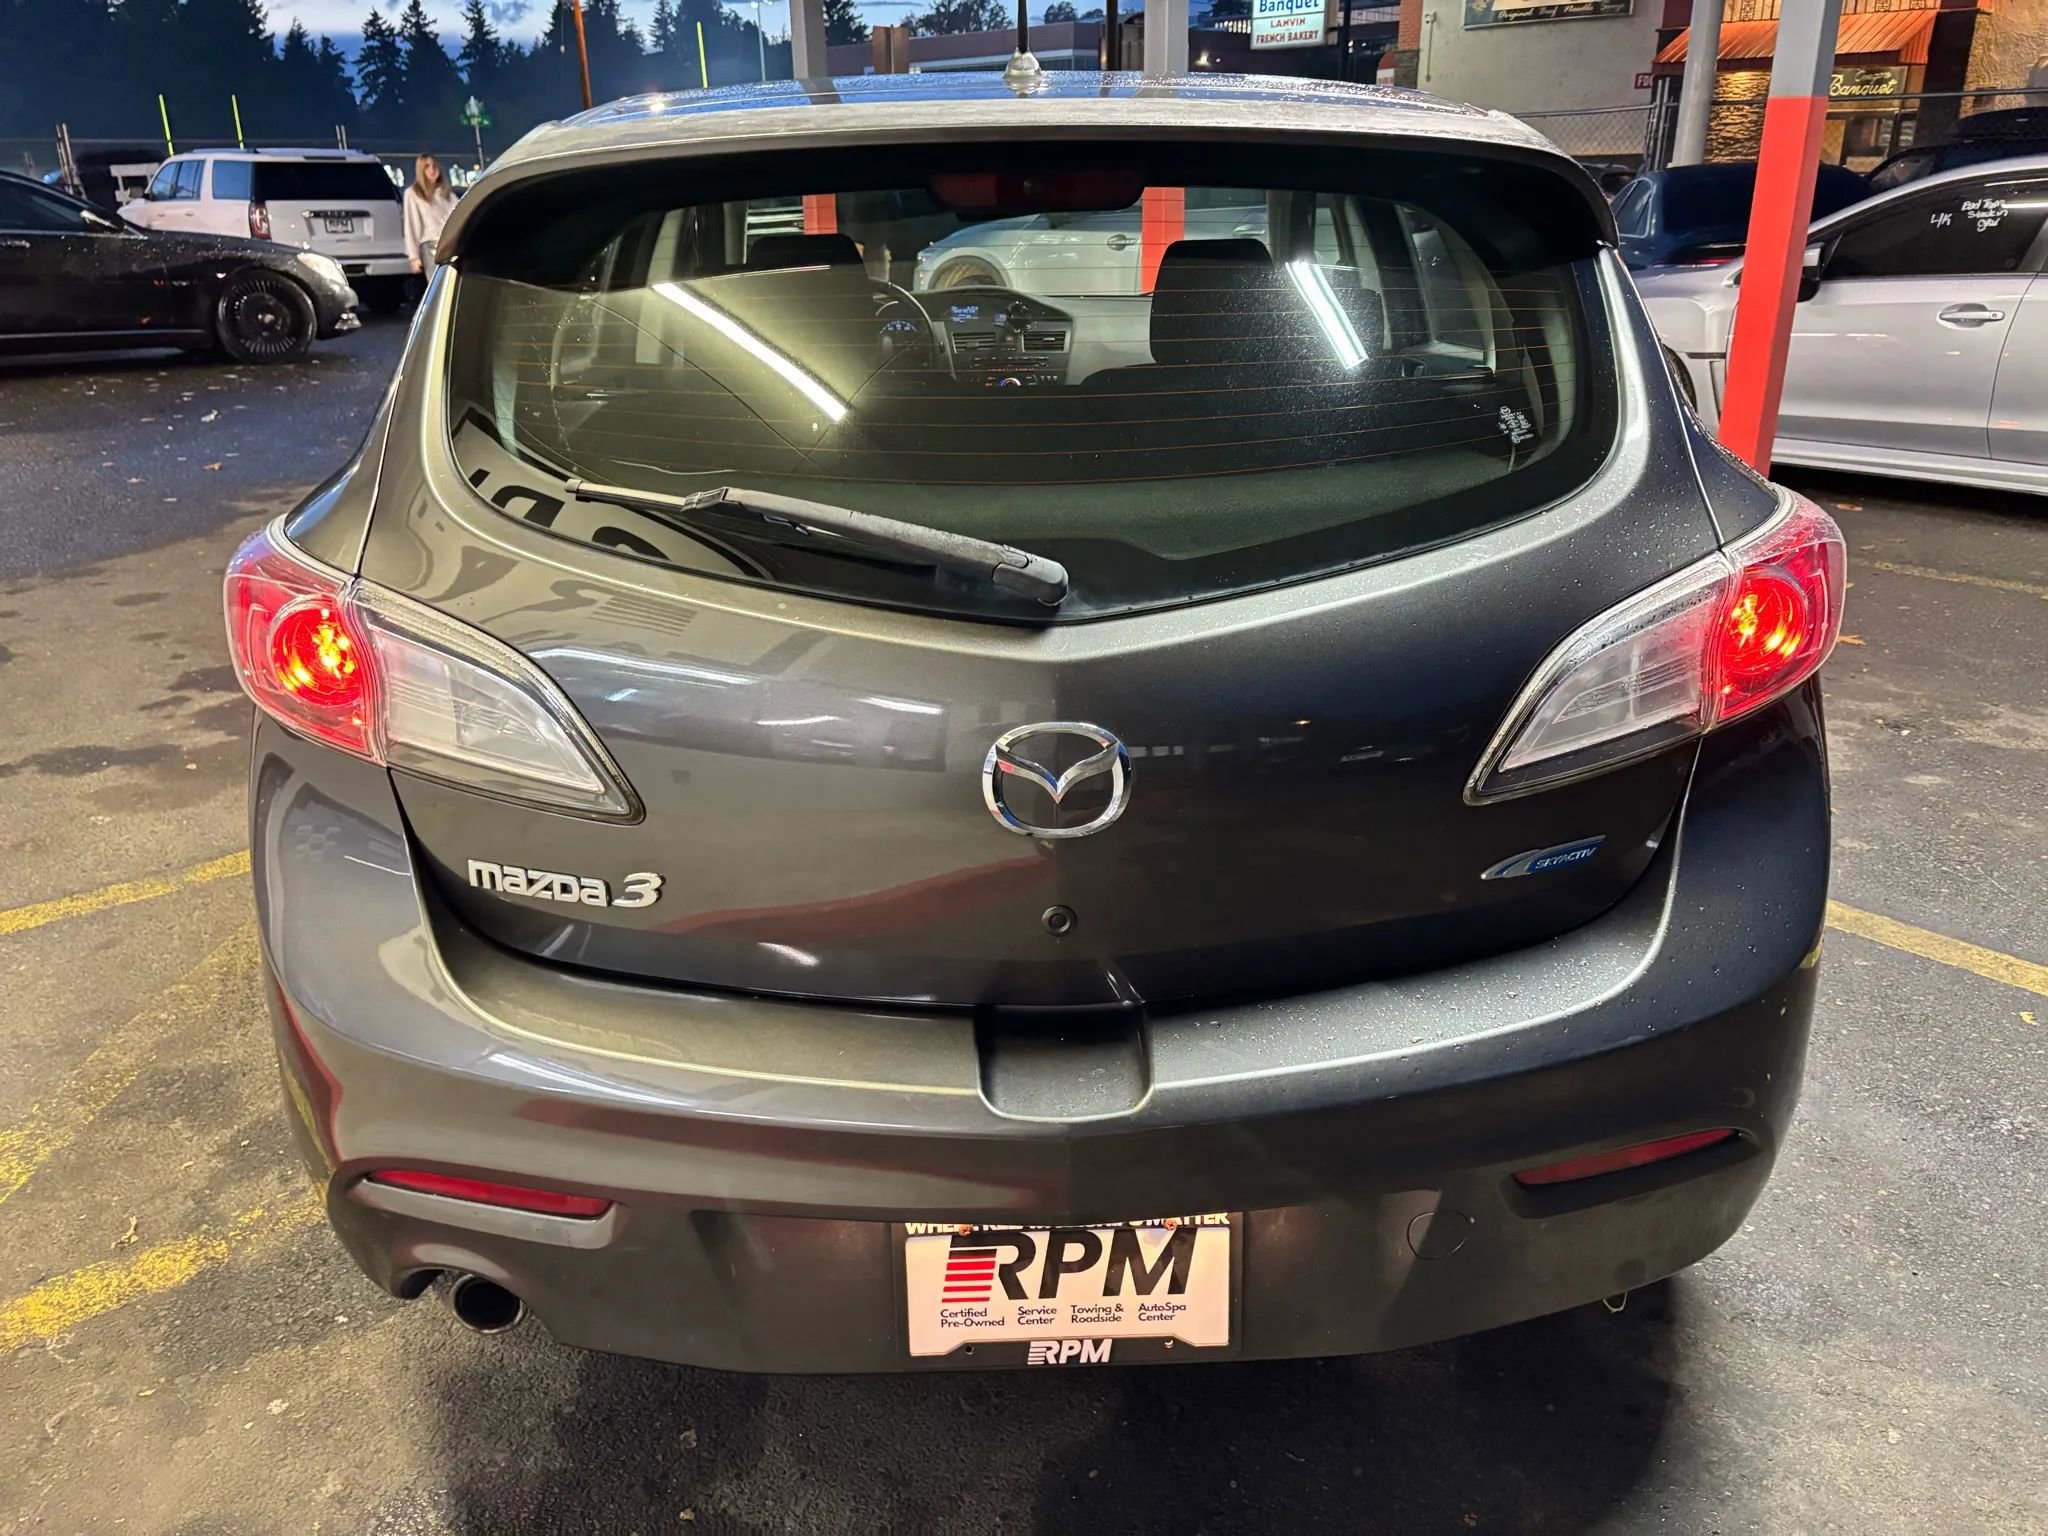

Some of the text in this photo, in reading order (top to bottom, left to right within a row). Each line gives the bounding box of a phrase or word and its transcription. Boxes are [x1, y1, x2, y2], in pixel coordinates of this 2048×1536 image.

[1259, 0, 1319, 15] Banquet
[1498, 8, 1534, 21] Original
[1256, 30, 1319, 44] FRENCH BAKERY
[1829, 74, 1898, 97] Banquet
[1961, 199, 1982, 211] Bad
[1535, 847, 1597, 869] SKYACTIV
[611, 871, 666, 908] 3
[942, 1227, 1198, 1303] RPM
[940, 1307, 988, 1318] Certified
[1017, 1305, 1058, 1316] Service
[1070, 1303, 1125, 1315] Towing &
[1138, 1302, 1187, 1314] AutoSpa
[940, 1316, 1005, 1328] Pre-Owned
[1017, 1315, 1055, 1326] Center
[1071, 1313, 1122, 1324] Roadside
[1138, 1312, 1176, 1322] Center
[1027, 1338, 1113, 1365] RPM
